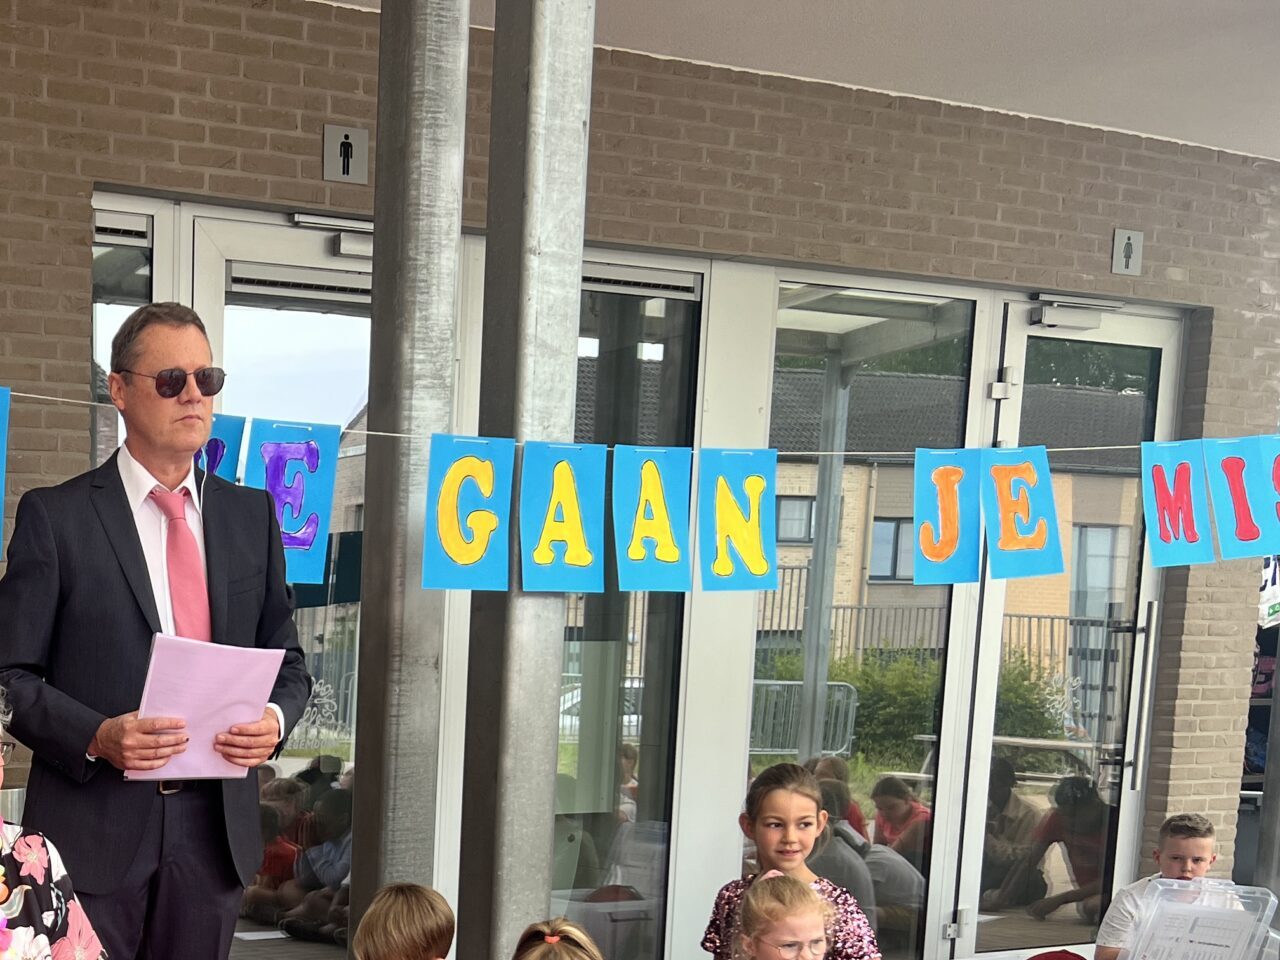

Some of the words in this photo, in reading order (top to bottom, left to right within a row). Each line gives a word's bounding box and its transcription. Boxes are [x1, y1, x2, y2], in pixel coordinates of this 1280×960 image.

[194, 437, 320, 551] E
[437, 454, 770, 577] GAAN
[919, 460, 1048, 563] JE
[1152, 453, 1280, 544] MI
